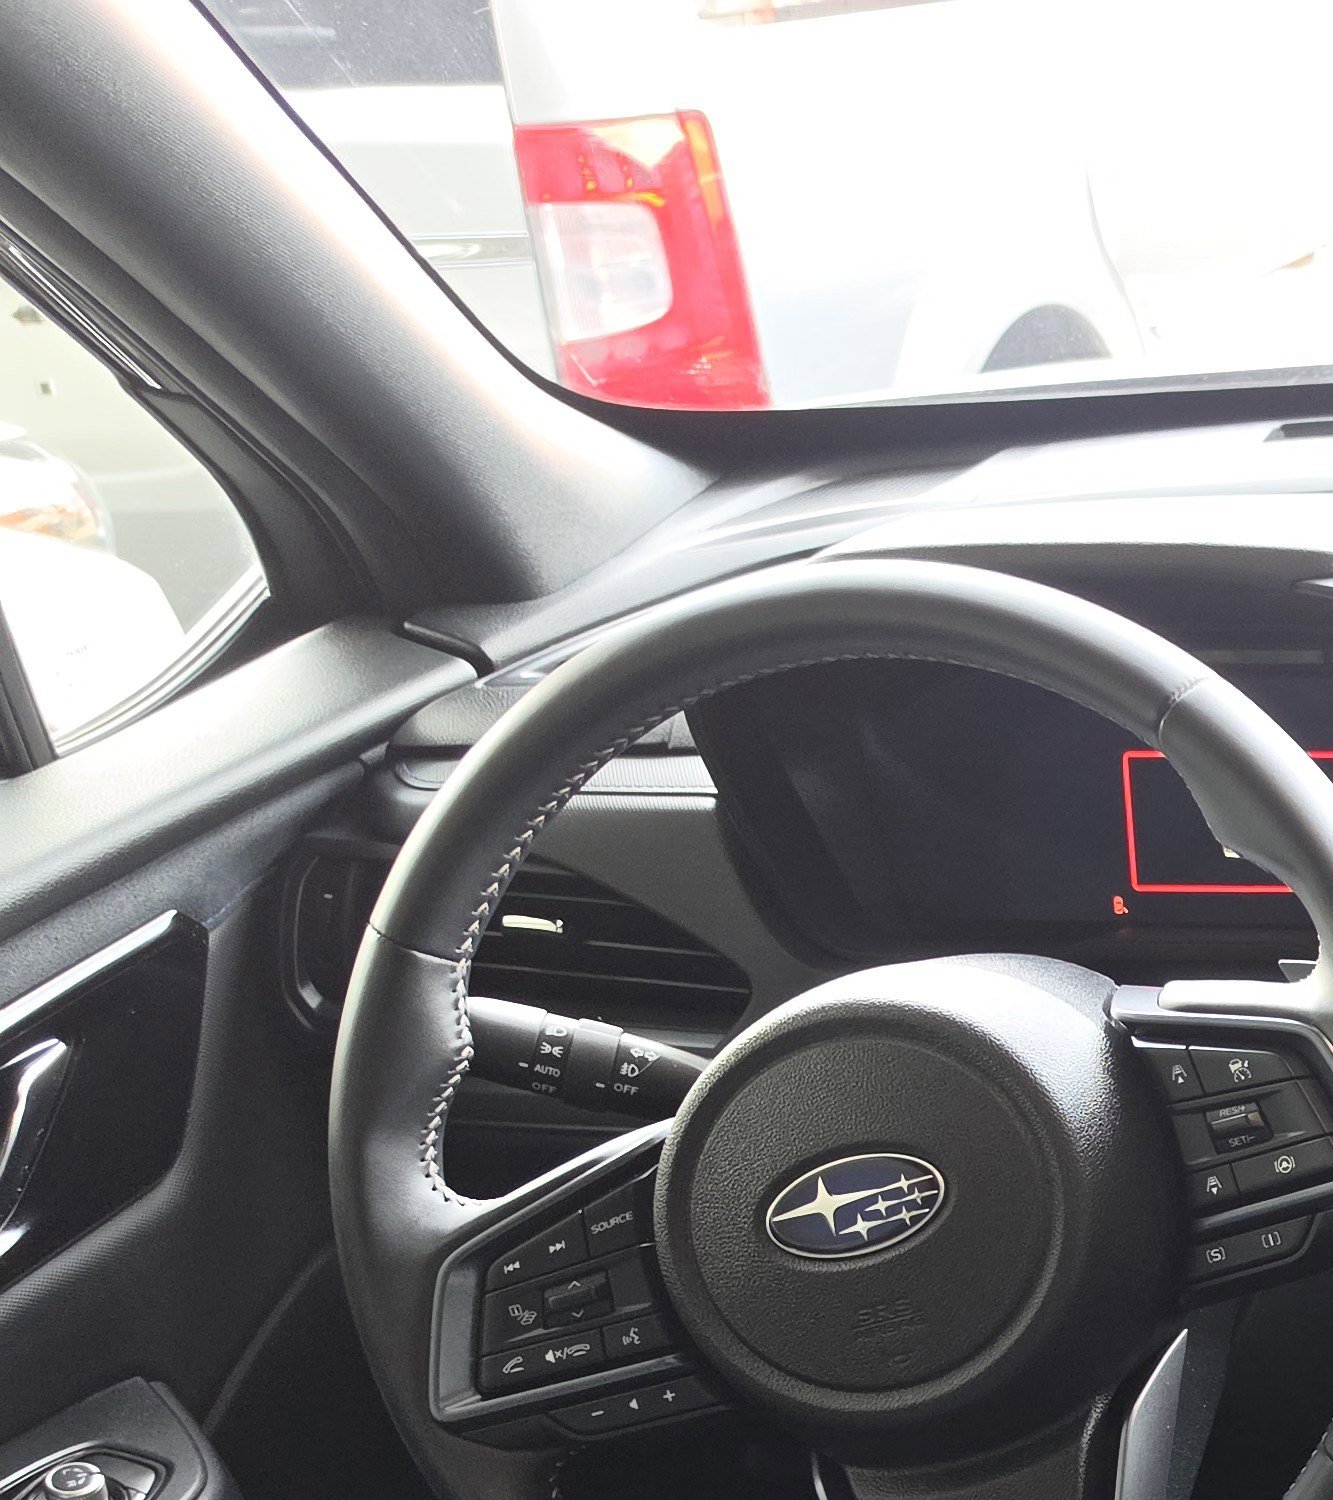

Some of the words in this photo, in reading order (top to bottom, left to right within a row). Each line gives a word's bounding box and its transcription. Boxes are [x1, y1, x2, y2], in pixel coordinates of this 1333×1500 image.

[534, 1063, 561, 1078] AUTO
[532, 1082, 558, 1094] OFF
[613, 1082, 640, 1095] OFF
[590, 1210, 634, 1235] SOURCE
